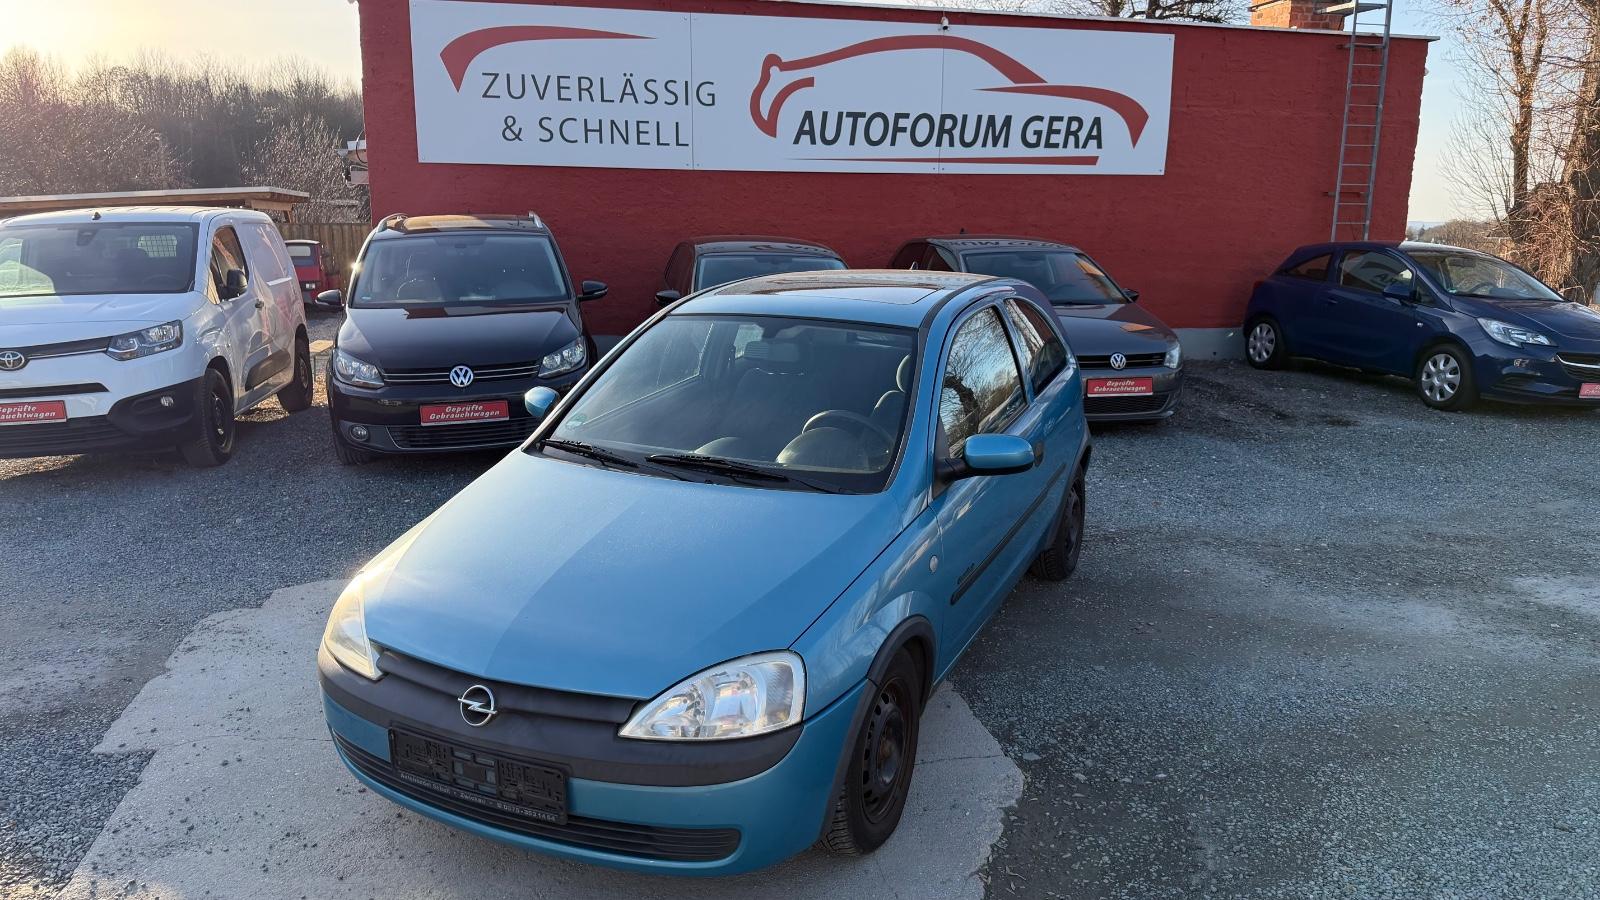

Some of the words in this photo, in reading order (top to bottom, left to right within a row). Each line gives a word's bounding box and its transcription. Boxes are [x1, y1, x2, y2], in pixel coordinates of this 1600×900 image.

[481, 72, 717, 107] ZUVERLÄSSIG
[501, 115, 524, 142] &
[538, 116, 690, 147] SCHNELL
[792, 109, 1013, 149] AUTOFORUM
[1020, 114, 1104, 150] GERA
[429, 411, 500, 420] Gebrauchtwagen
[445, 404, 483, 413] Geprüfte
